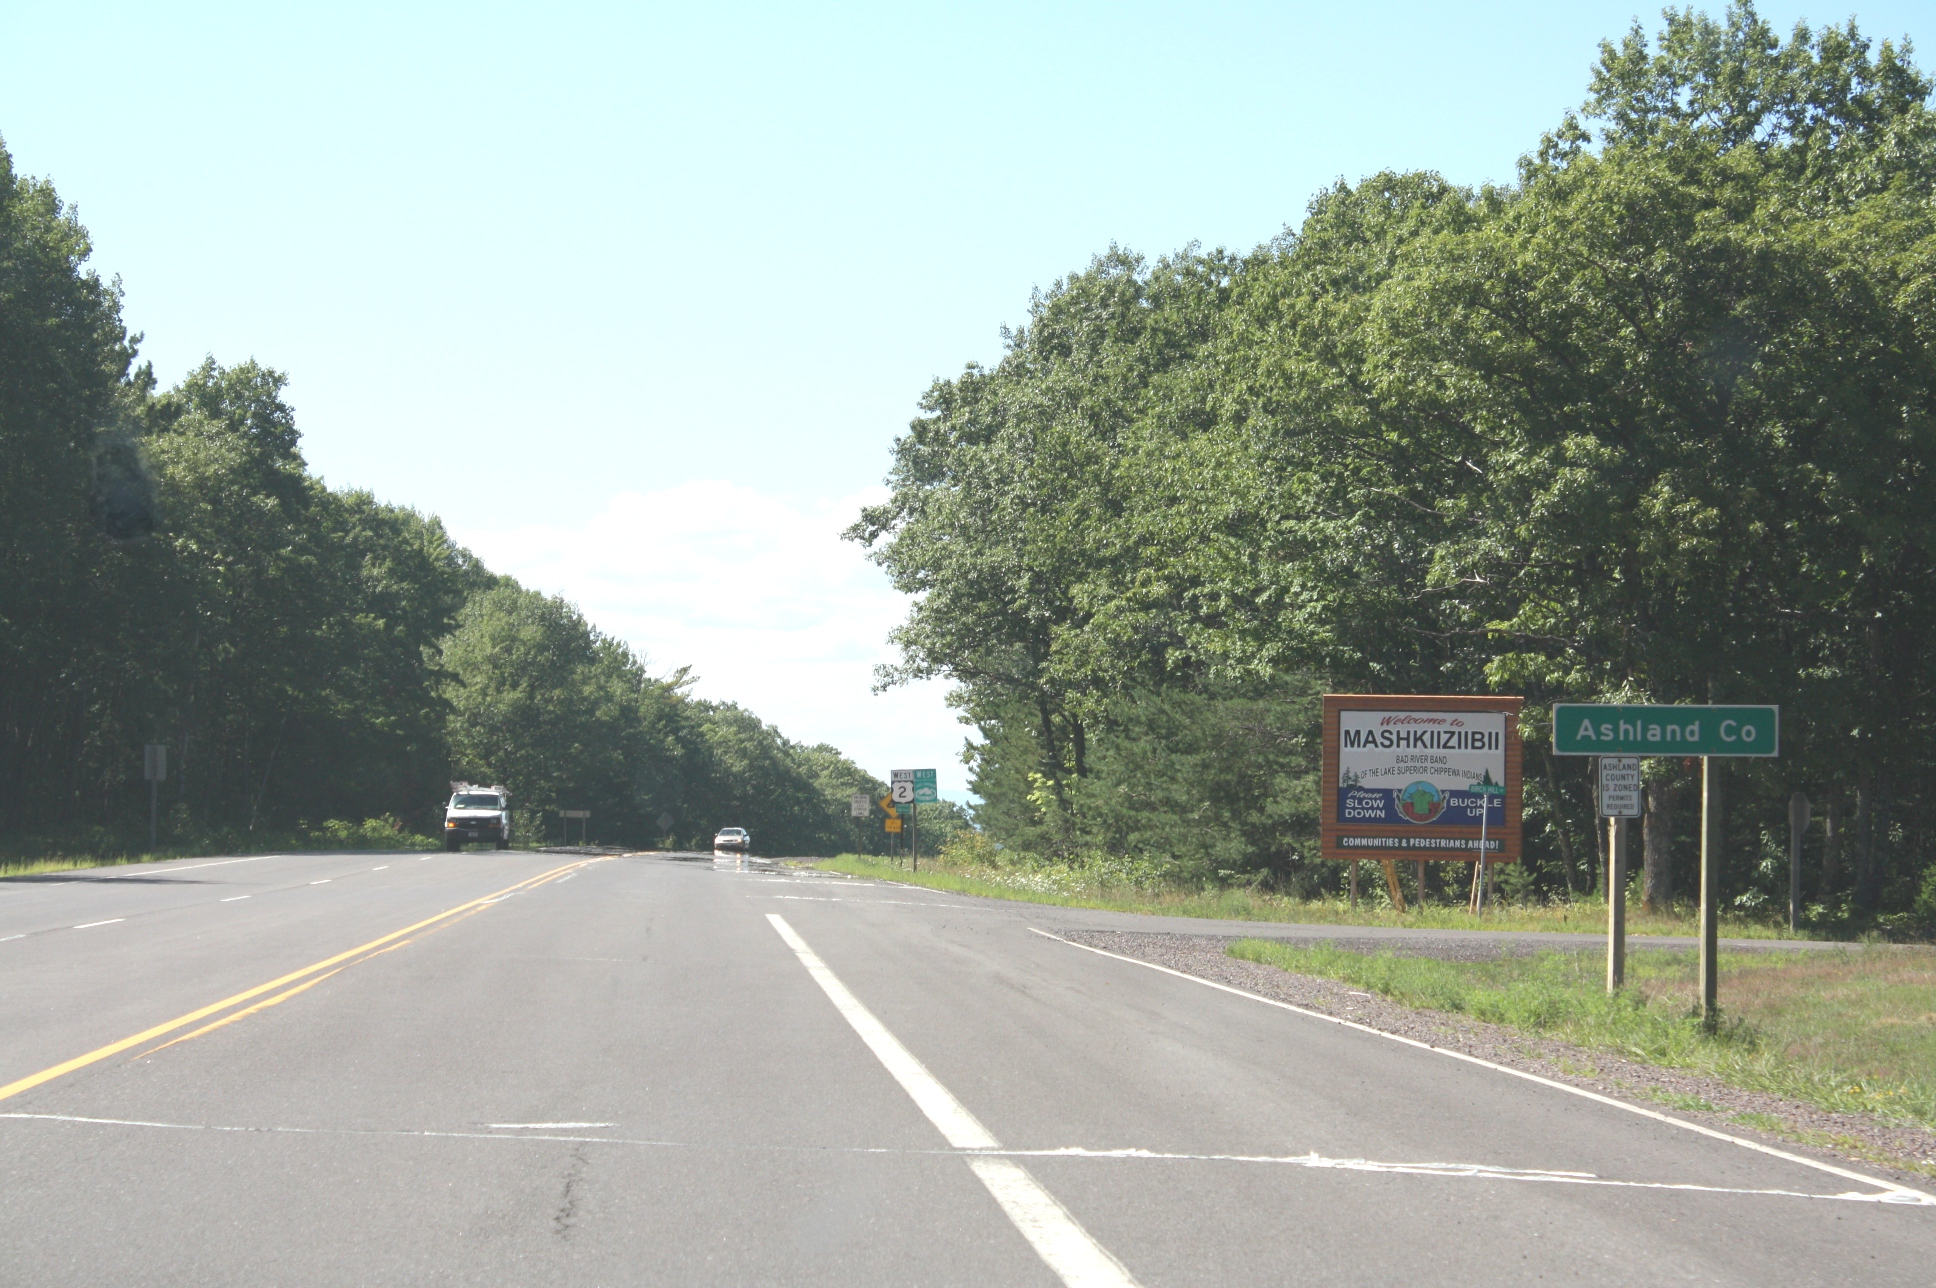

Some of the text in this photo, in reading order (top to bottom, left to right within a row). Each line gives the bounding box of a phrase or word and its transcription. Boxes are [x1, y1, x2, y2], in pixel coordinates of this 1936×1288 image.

[1380, 715, 1464, 727] Welcome to
[1576, 718, 1756, 742] Ashland Co
[1344, 730, 1499, 750] MASHKIIZIIBII
[1396, 755, 1447, 765] BAD RIVER BAND
[1361, 766, 1482, 781] OF THE LAKE SUPERIOR CHIPPEWA INDIANS
[898, 786, 906, 798] 2
[1346, 799, 1385, 808] SLOW
[1346, 809, 1385, 818] DOWN
[1467, 808, 1484, 816] UP
[1343, 838, 1399, 847] COMMUNITIES
[1401, 839, 1407, 847] &
[1410, 839, 1466, 848] PEDESTRIANS
